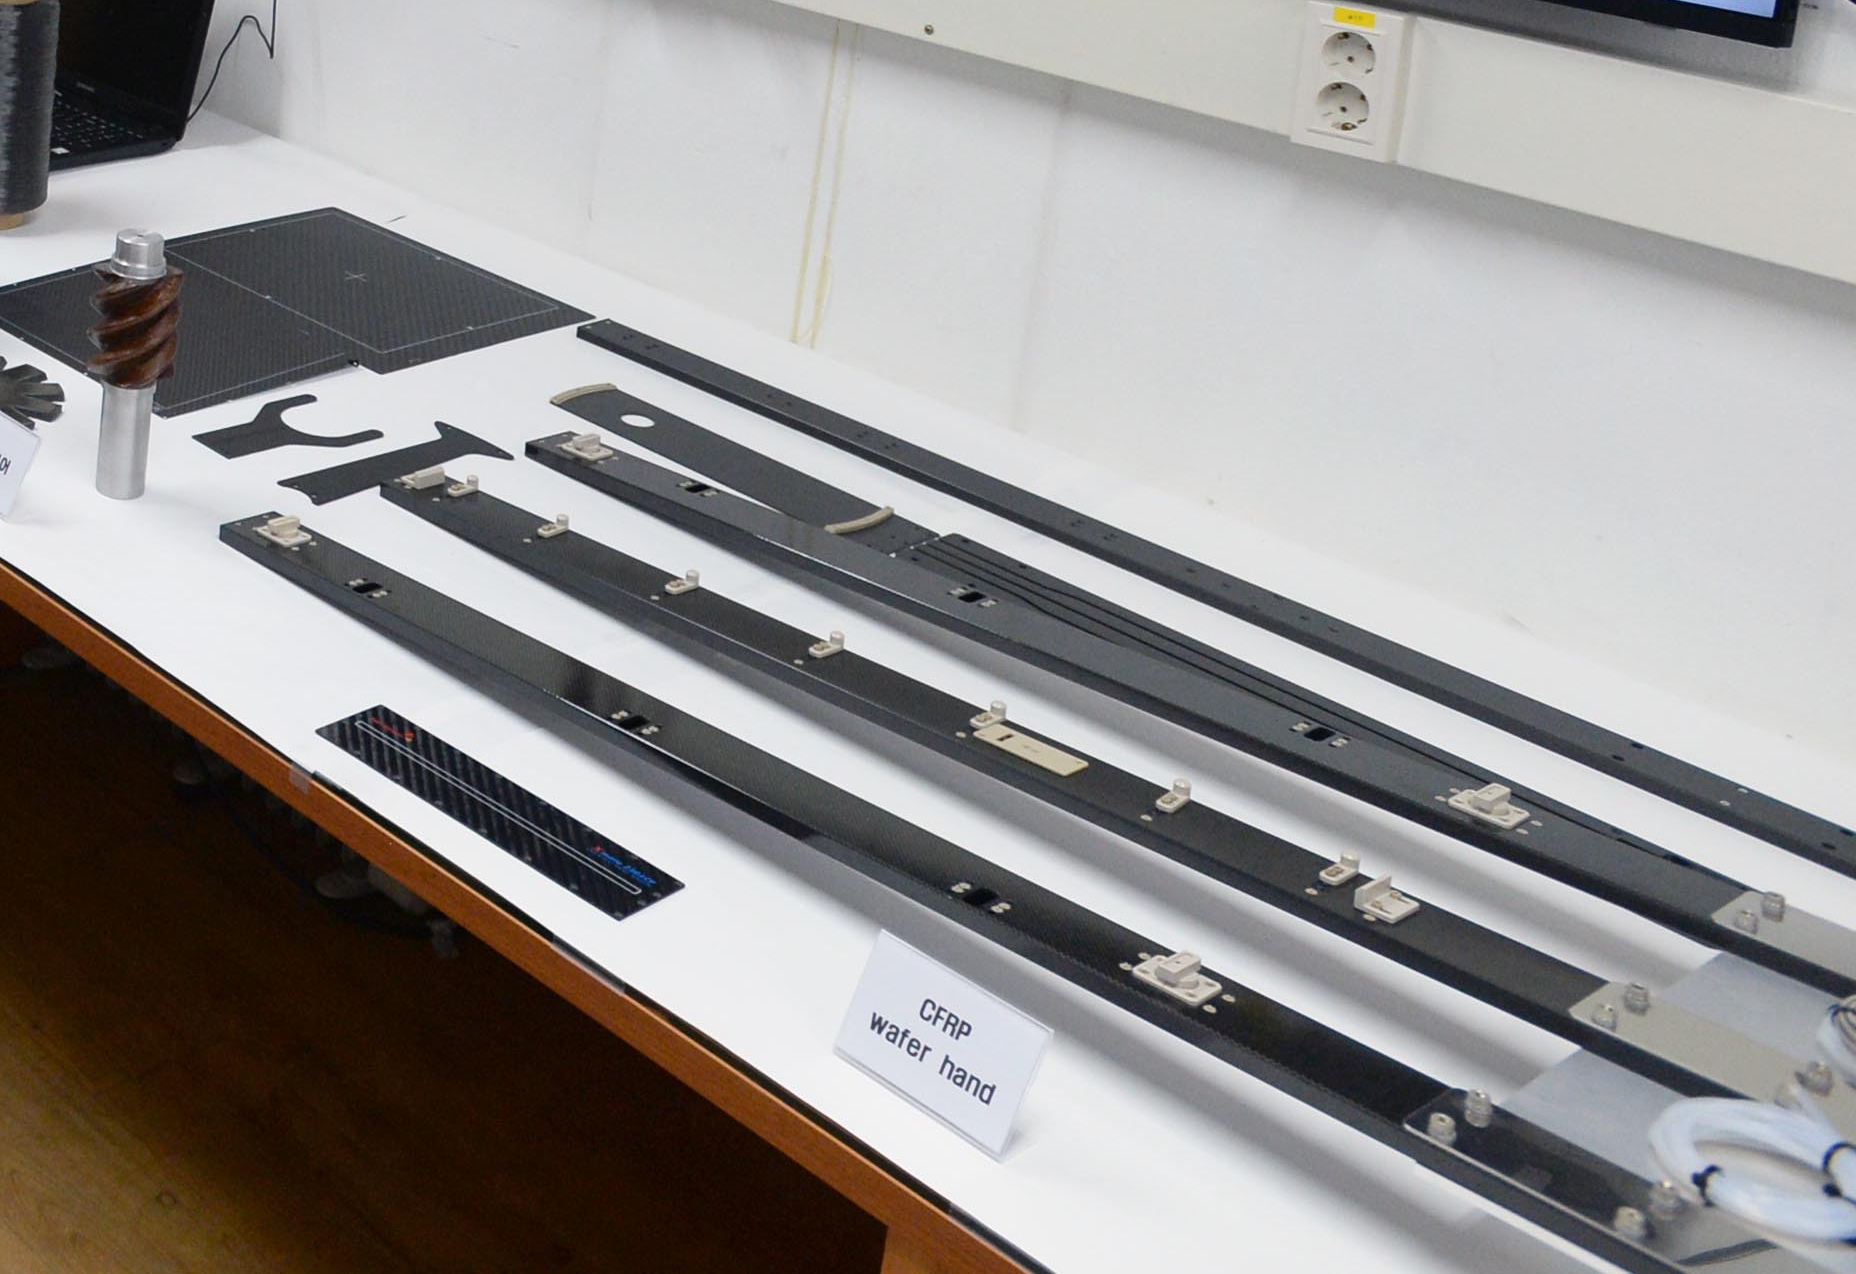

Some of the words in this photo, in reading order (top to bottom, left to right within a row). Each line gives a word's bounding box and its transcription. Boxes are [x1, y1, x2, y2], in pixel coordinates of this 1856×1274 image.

[919, 998, 972, 1041] CFRP
[870, 1011, 932, 1062] wafer
[938, 1054, 996, 1105] hand
